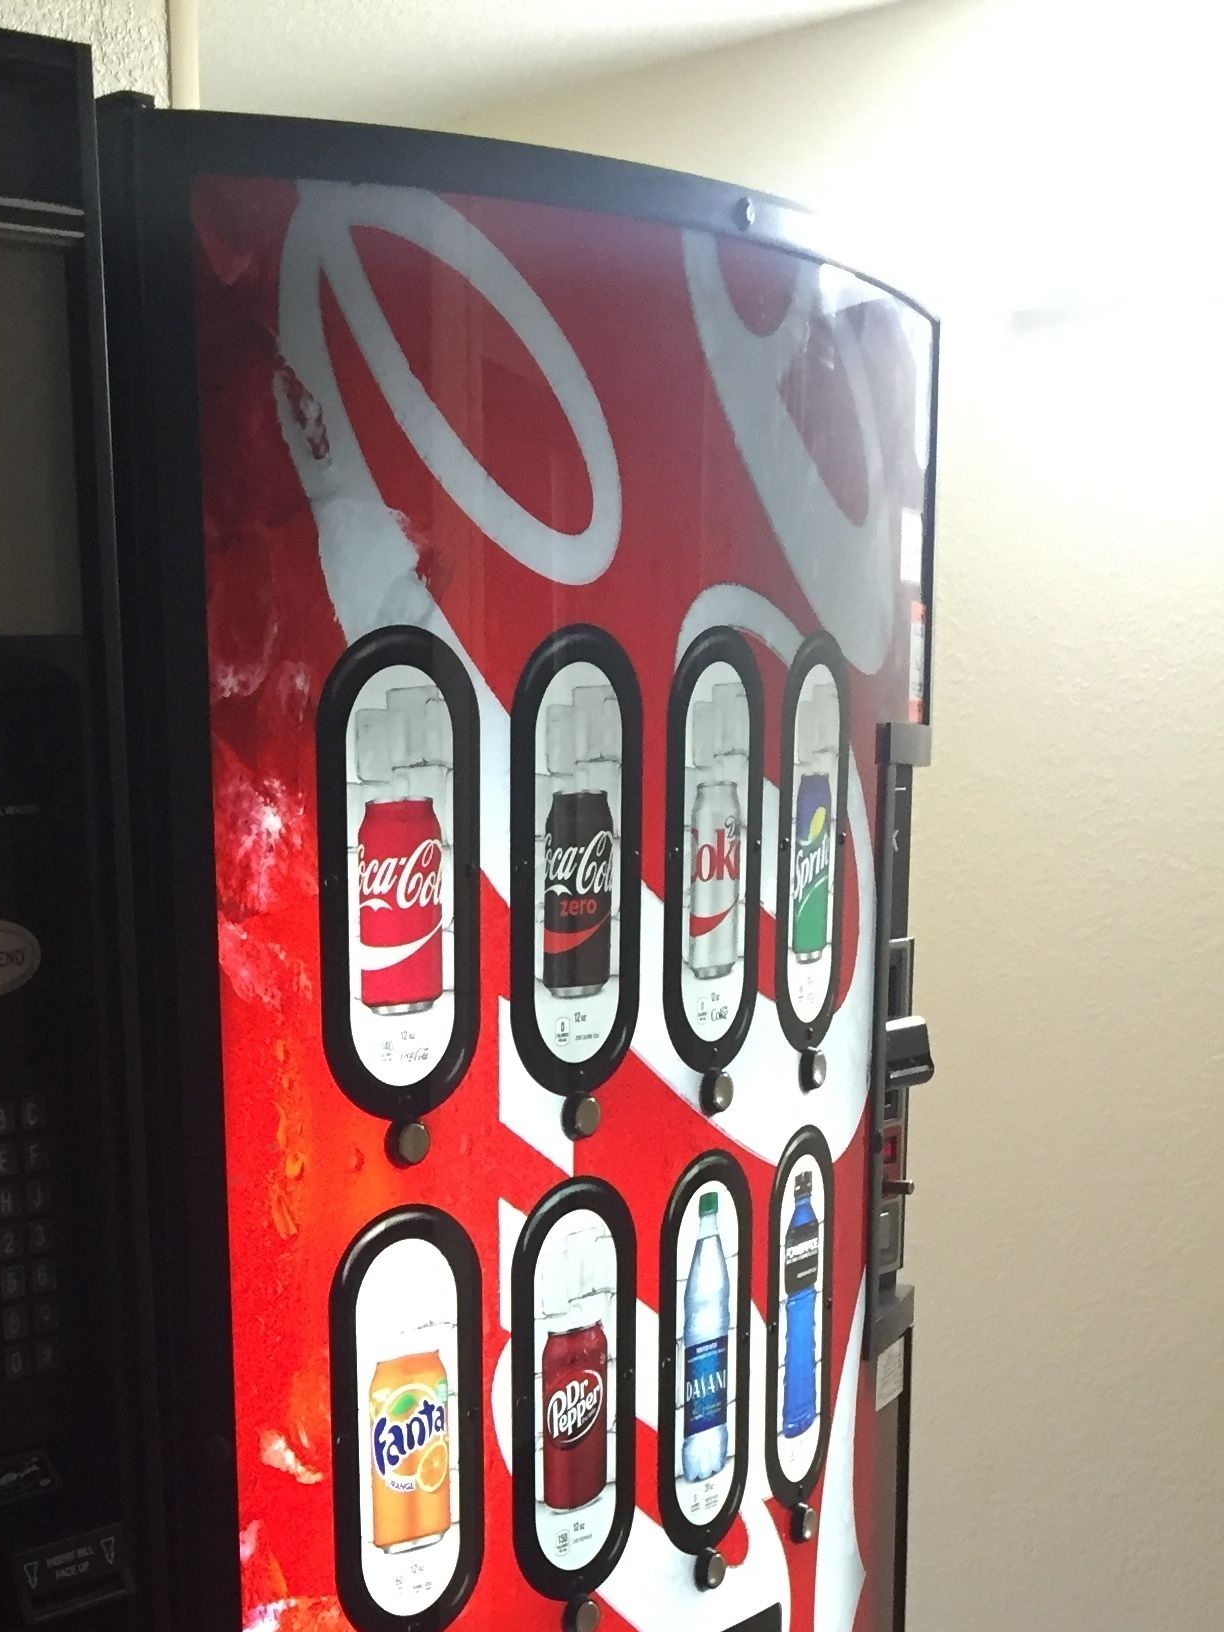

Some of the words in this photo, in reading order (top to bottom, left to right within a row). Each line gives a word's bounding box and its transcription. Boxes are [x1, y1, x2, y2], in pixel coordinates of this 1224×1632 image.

[559, 896, 598, 919] zero
[567, 1378, 590, 1405] Dr
[547, 1385, 601, 1441] Pepper
[374, 1399, 446, 1475] Fanta
